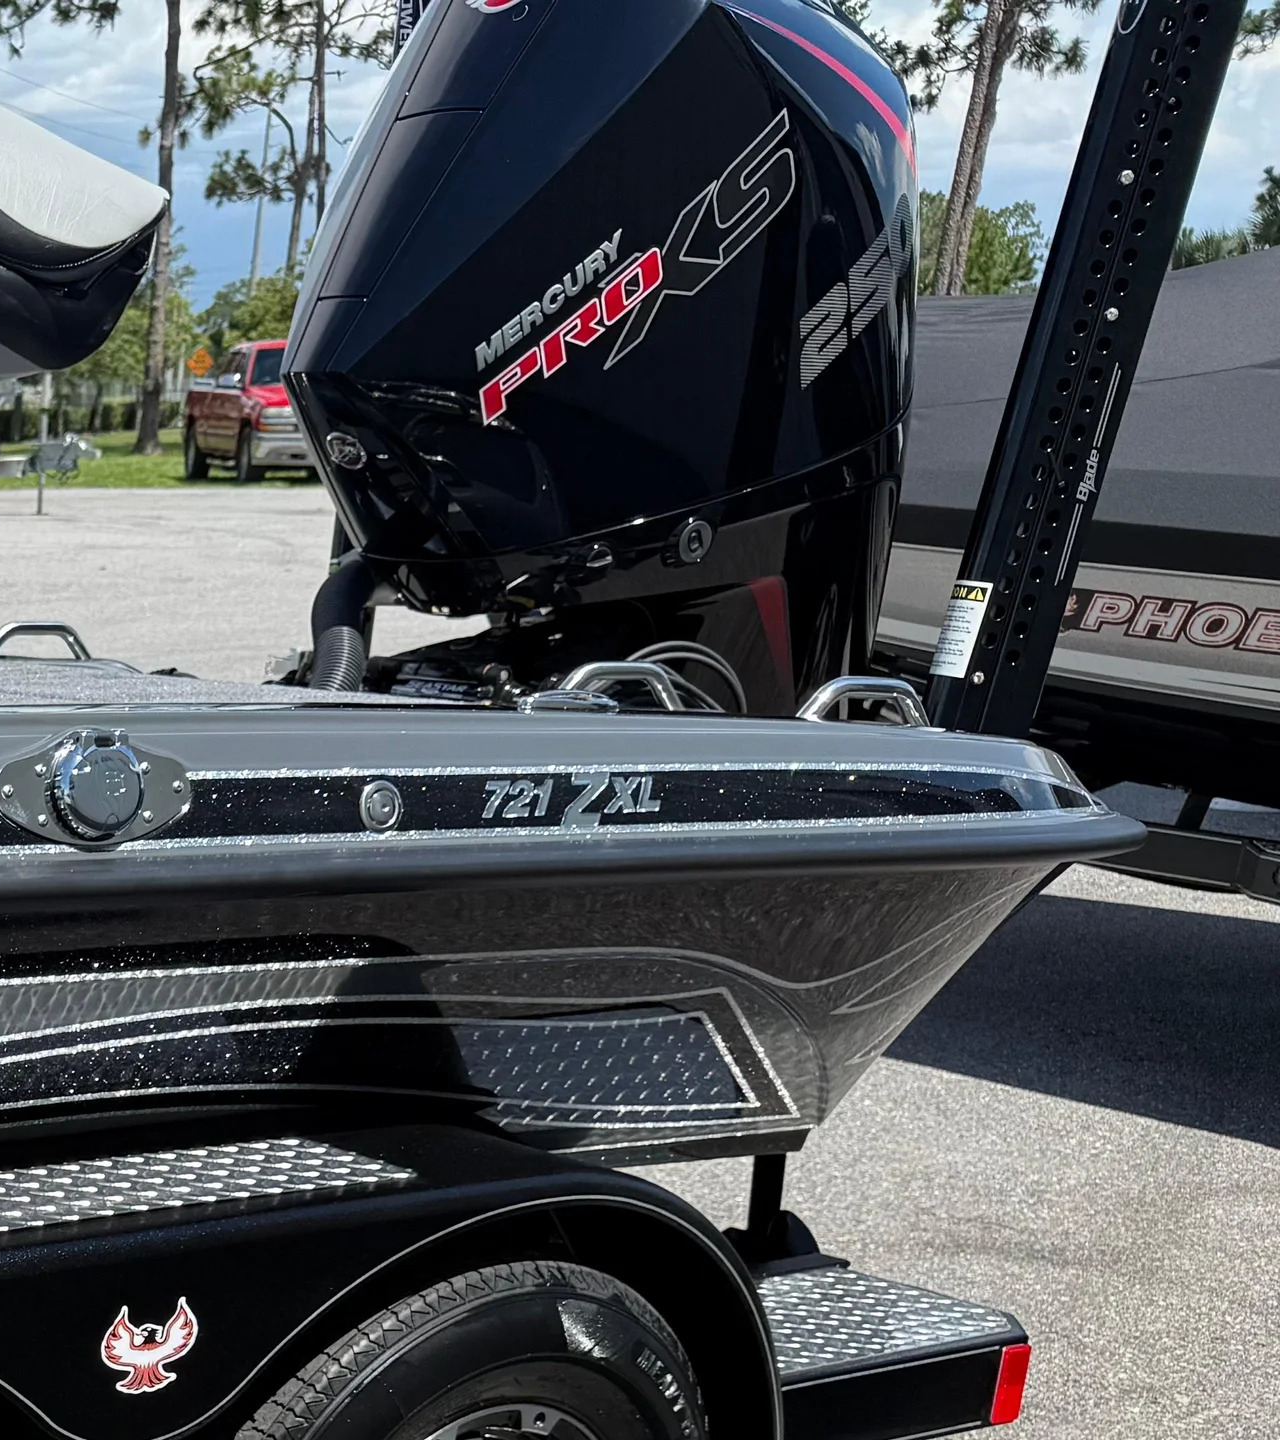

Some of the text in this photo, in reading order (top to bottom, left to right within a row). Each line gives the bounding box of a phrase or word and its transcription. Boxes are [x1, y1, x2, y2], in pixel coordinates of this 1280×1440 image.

[475, 228, 622, 371] MERCURY
[480, 247, 663, 424] PRO
[799, 193, 911, 390] 250
[1076, 449, 1099, 502] Blade
[482, 779, 554, 819] 721
